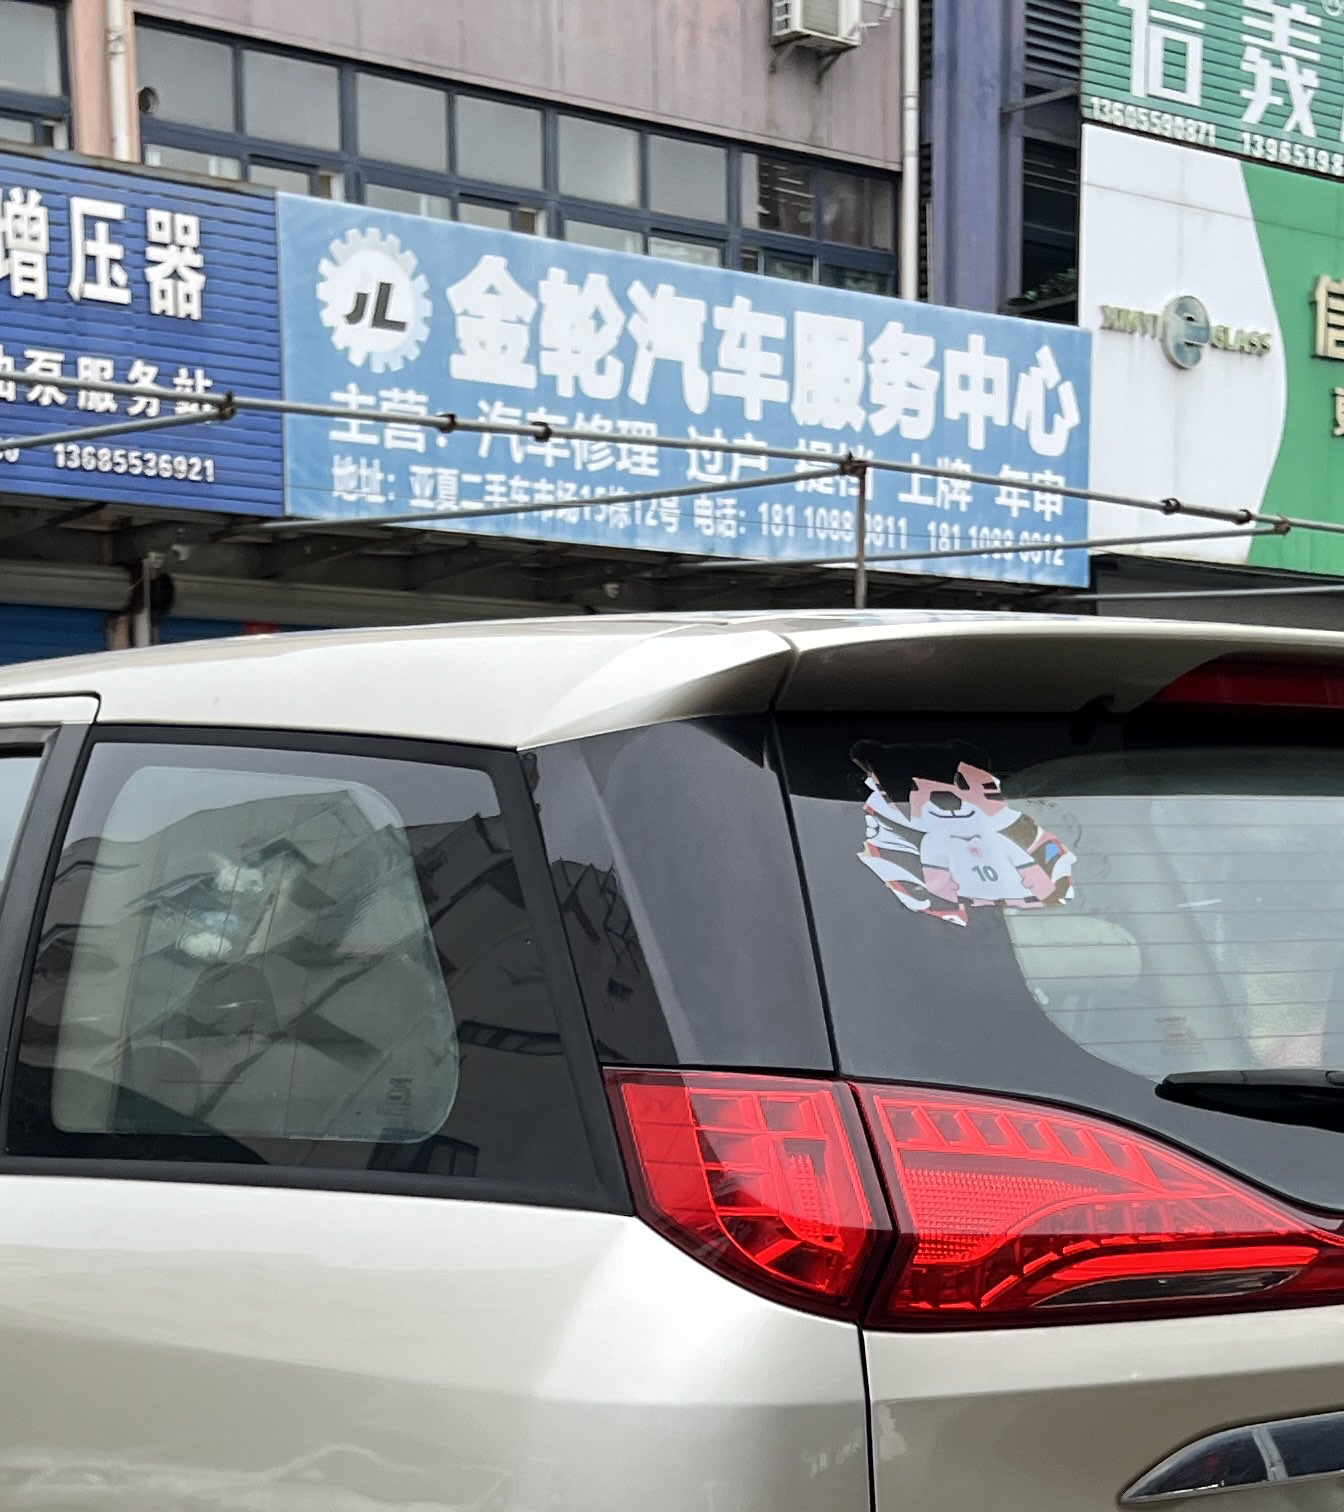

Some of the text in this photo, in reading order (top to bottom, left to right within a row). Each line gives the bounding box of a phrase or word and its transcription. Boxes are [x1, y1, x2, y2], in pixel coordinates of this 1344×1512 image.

[346, 282, 407, 332] JL
[446, 254, 1081, 457] 金轮汽车服务中心
[54, 444, 215, 482] 13685536921
[687, 425, 769, 483] 过户
[898, 452, 972, 513] 上牌
[994, 465, 1067, 522] 年审
[971, 865, 999, 883] 10
